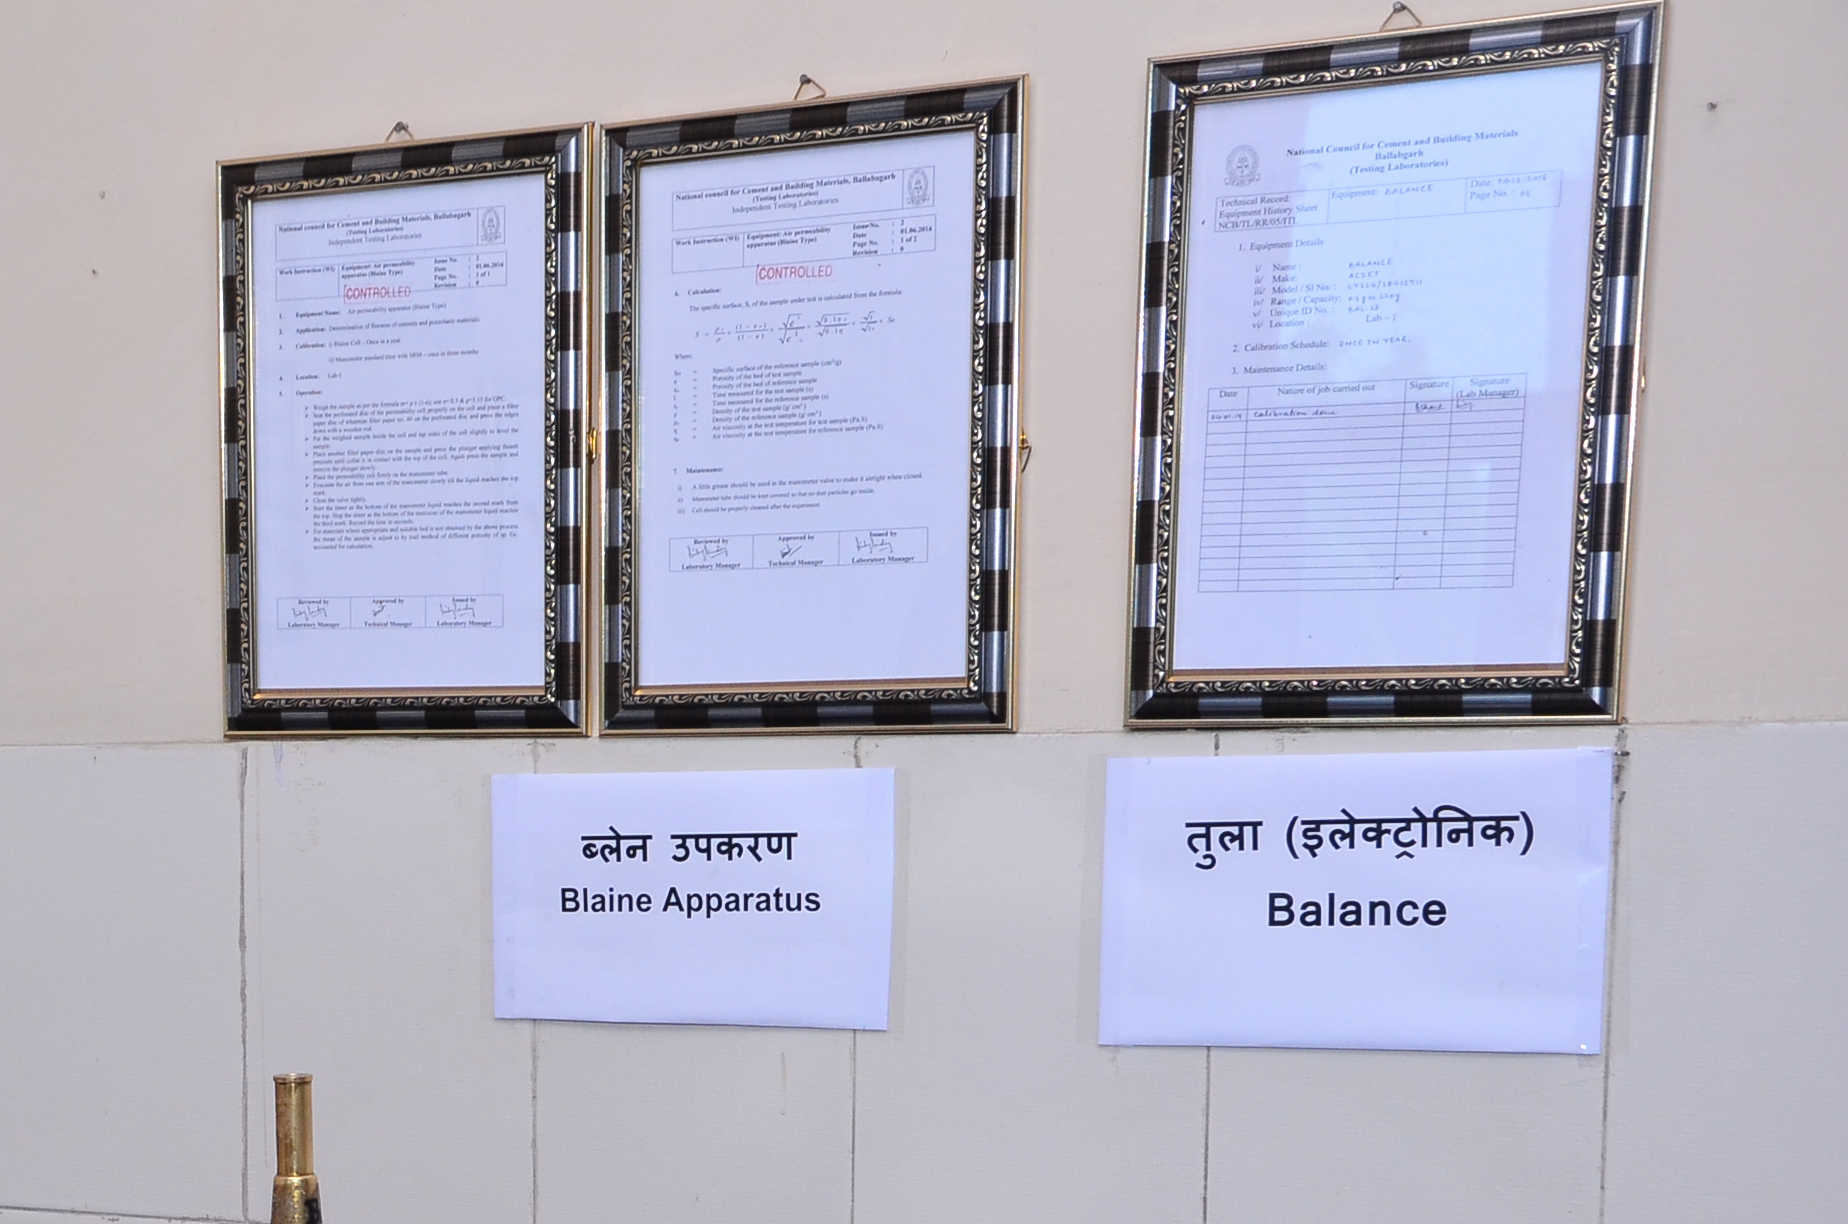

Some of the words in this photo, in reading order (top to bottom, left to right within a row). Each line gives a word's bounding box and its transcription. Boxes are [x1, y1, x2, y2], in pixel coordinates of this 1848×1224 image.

[1287, 146, 1324, 156] National
[1326, 143, 1360, 153] Council
[1362, 142, 1374, 150] for
[1378, 140, 1411, 149] Cement
[1414, 137, 1430, 146] and
[1433, 133, 1471, 144] Building
[1475, 130, 1518, 140] Materials
[1388, 159, 1448, 171] Laboratories)
[675, 192, 703, 201] National
[742, 185, 769, 195] Cement
[770, 184, 783, 193] and
[785, 180, 814, 191] Building
[1470, 191, 1491, 200] Page
[732, 203, 771, 214] Independent
[773, 201, 797, 210] Testing
[799, 198, 839, 208] Laboratories
[1220, 197, 1257, 207] Technical
[1219, 209, 1261, 219] Equipment
[1264, 206, 1292, 216] History
[1296, 204, 1317, 213] Sheet
[279, 225, 302, 233] National
[1250, 241, 1292, 251] Equipment
[1296, 239, 1323, 248] Details
[759, 265, 832, 280] CONTROLLED
[346, 286, 411, 299] CONTROLLED
[1272, 285, 1298, 294] Model
[1271, 297, 1297, 307] Range
[1270, 308, 1299, 318] Unique
[1269, 320, 1305, 328] Location
[1245, 341, 1288, 352] Calibration
[1243, 365, 1294, 374] Maintenance
[1470, 376, 1510, 387] Signature
[1219, 389, 1238, 398] Date
[1277, 385, 1304, 395] Nature
[1317, 385, 1330, 397] job
[1331, 383, 1360, 393] carried
[1362, 383, 1375, 392] out
[1410, 379, 1449, 390] Signature
[670, 830, 798, 862] उपकरण
[1186, 819, 1263, 870] तुला
[561, 887, 652, 913] Blaine
[662, 885, 822, 919] Apparatus
[1268, 893, 1448, 927] Balance
